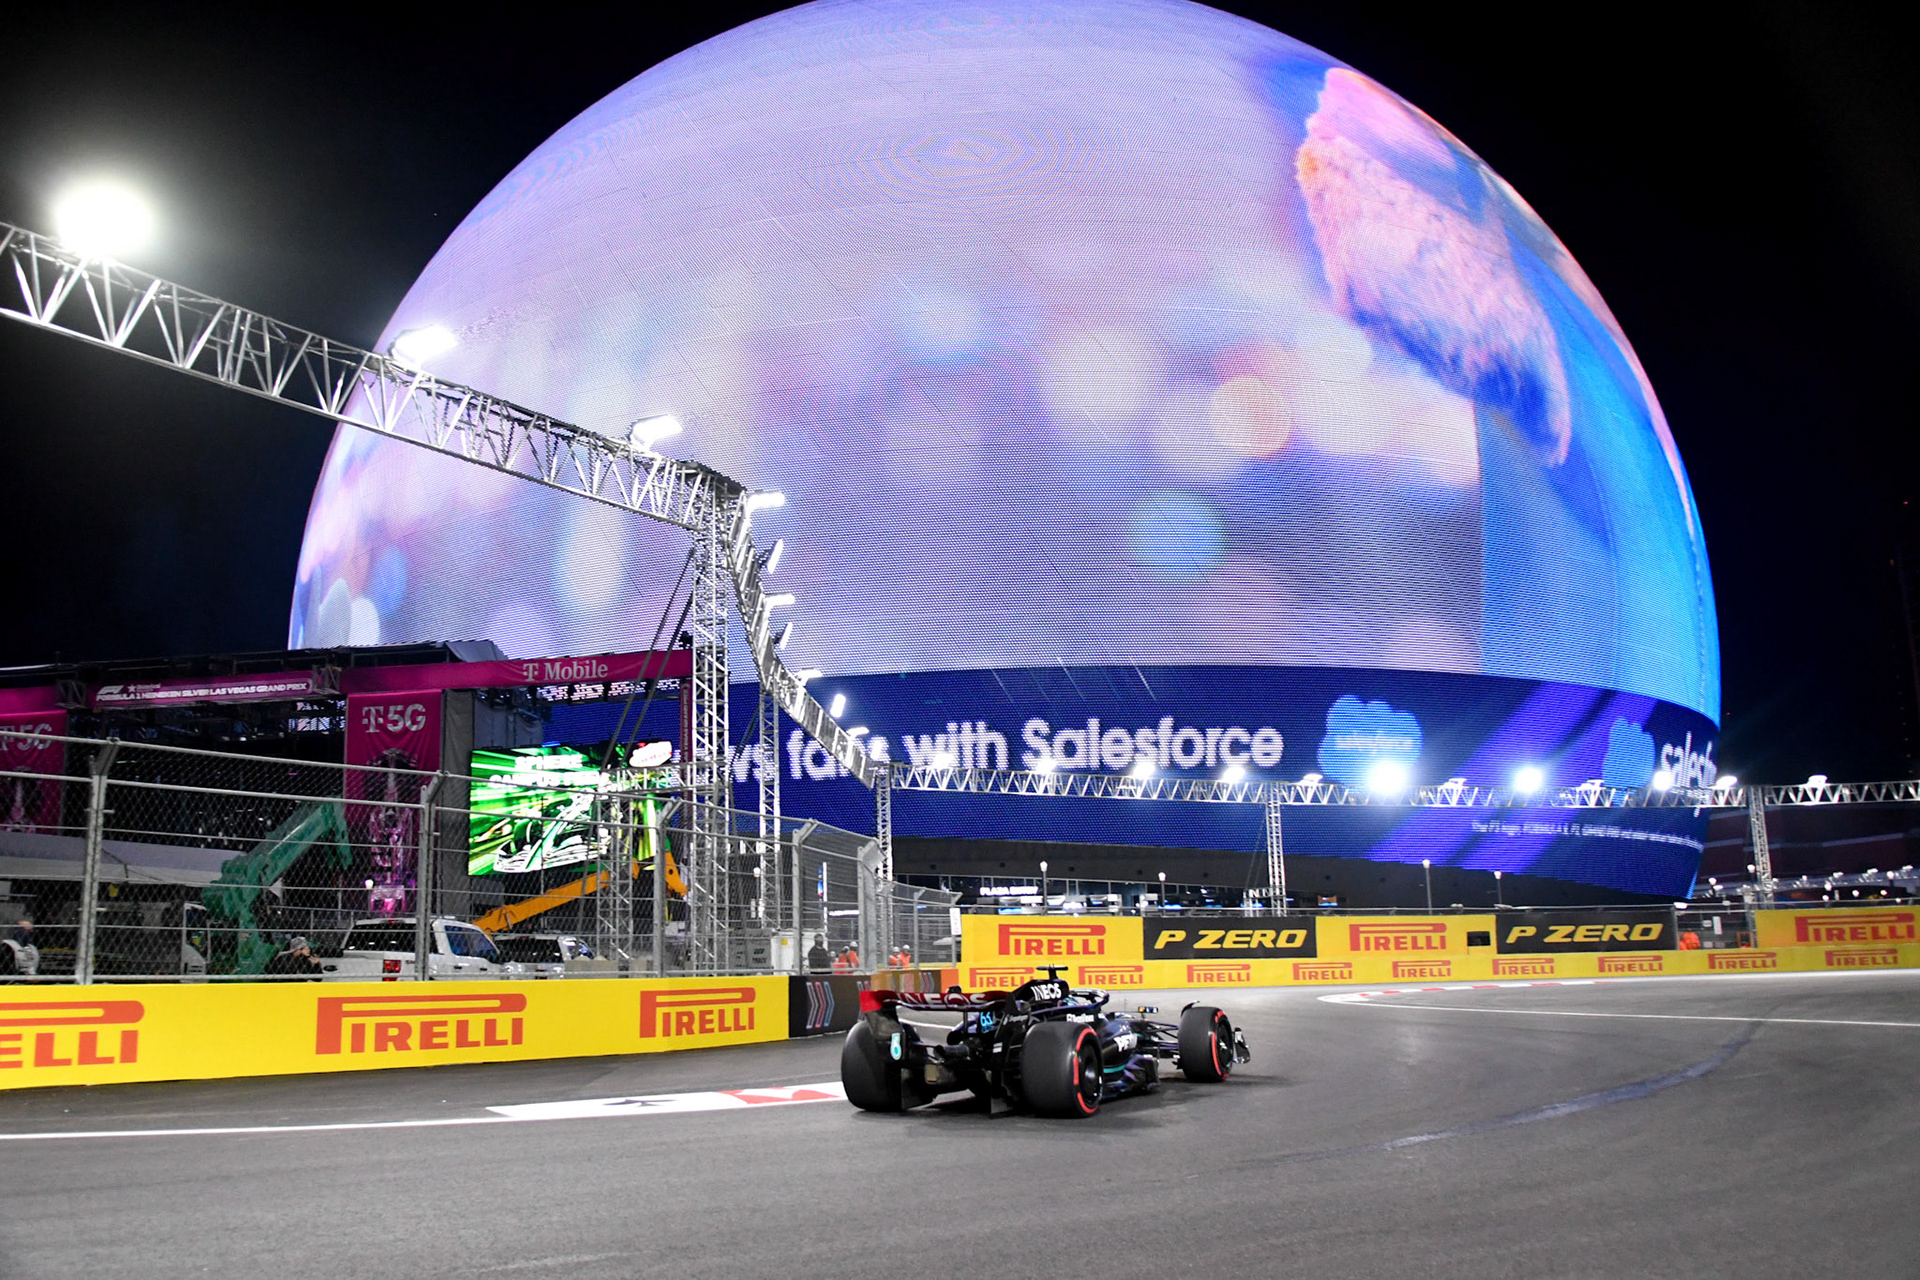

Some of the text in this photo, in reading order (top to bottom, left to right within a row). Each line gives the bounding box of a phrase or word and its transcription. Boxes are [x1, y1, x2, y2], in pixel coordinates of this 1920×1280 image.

[544, 660, 608, 681] Mobile
[181, 688, 209, 698] SILVER
[210, 687, 226, 696] LAS
[227, 685, 255, 695] VEGAS
[256, 683, 285, 693] GRAND
[286, 682, 307, 691] PRIX
[902, 720, 1010, 771] with
[1022, 715, 1285, 771] Salesforce
[1349, 923, 1447, 951] PIRELLI
[1506, 923, 1663, 944] P ZERO
[1794, 912, 1916, 943] PIRELLI
[998, 924, 1106, 955] PIRELLI
[1154, 929, 1308, 950] P ZERO
[1492, 958, 1554, 975] PIRELLI
[1598, 955, 1663, 973] PIRELLI
[1708, 952, 1777, 970] PIRELLI
[1825, 949, 1898, 967] PIRELLI
[1078, 965, 1144, 985] PIRELLI
[1187, 964, 1251, 983] PIRELLI
[1292, 962, 1353, 981] PIRELLI
[1392, 960, 1451, 978] PIRELLI
[1031, 983, 1062, 1001] INEOS
[639, 987, 756, 1038] PIRELLI
[316, 993, 527, 1055] PIRELLI
